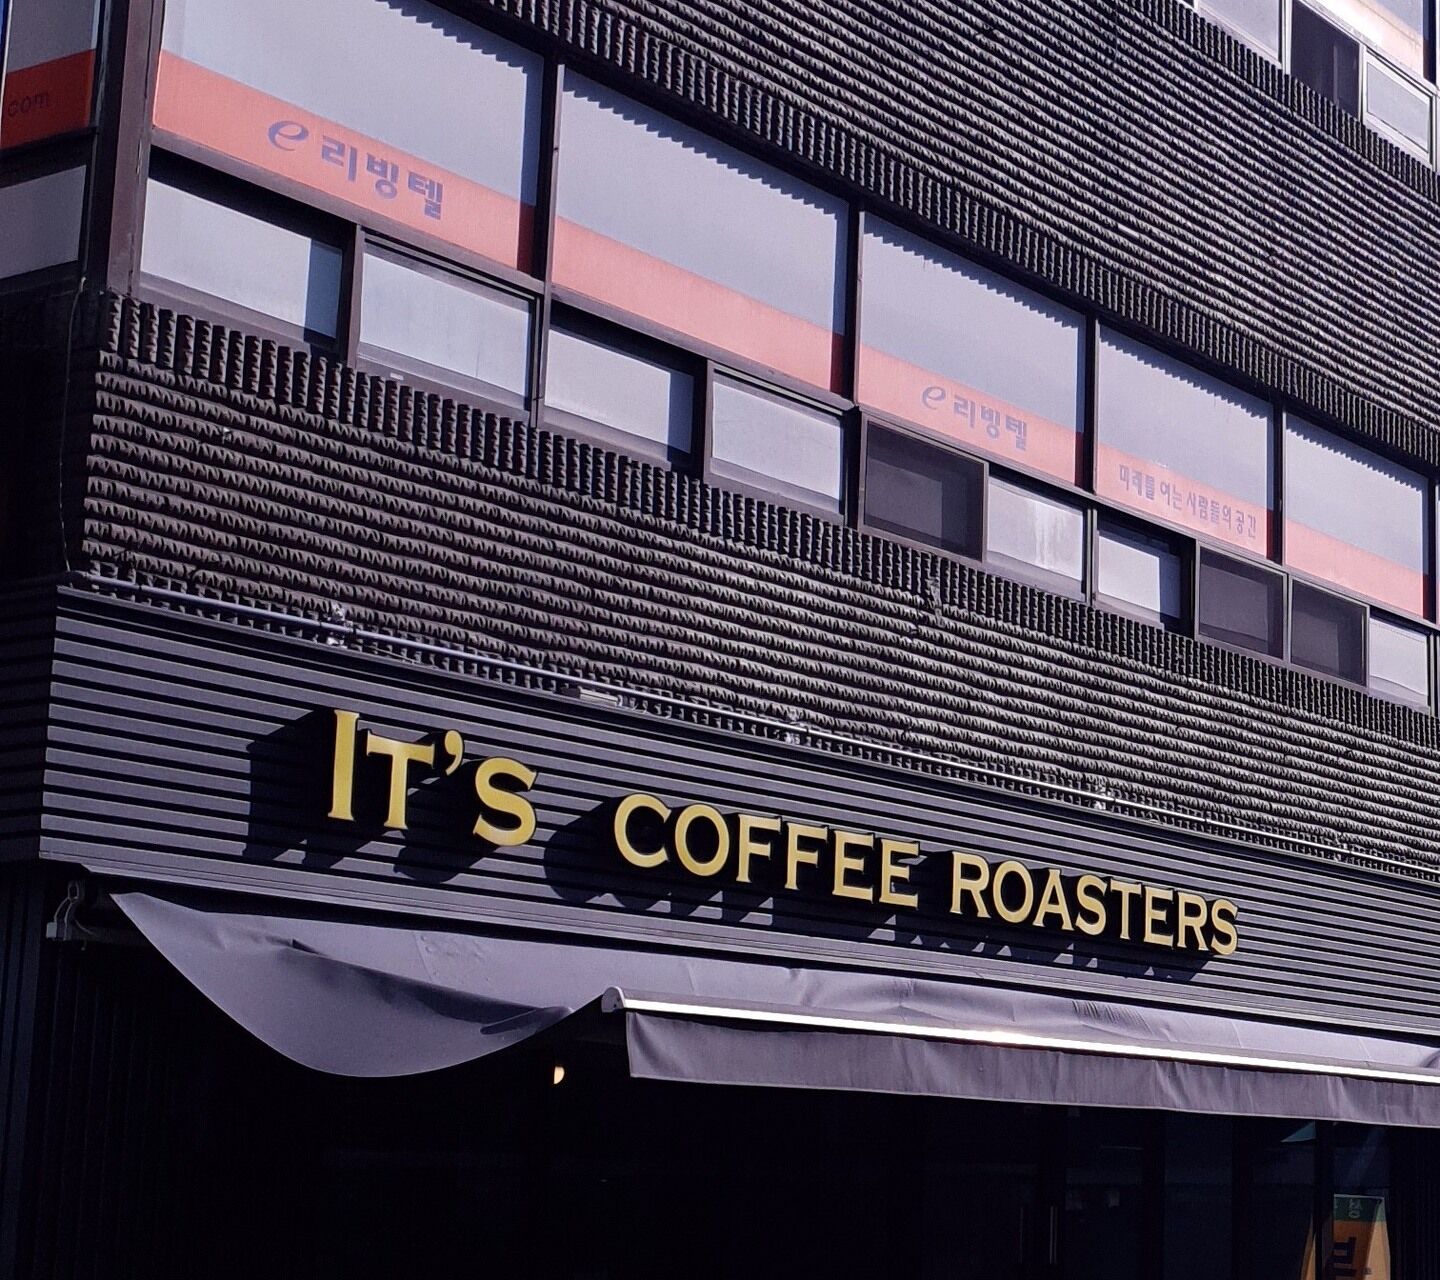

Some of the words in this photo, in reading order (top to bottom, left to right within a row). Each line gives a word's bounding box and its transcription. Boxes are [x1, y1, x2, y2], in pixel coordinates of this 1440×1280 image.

[1119, 464, 1155, 500] 미래를
[1160, 481, 1183, 510] 여는
[1186, 491, 1232, 530] 사람들의
[328, 709, 538, 847] IT'S
[614, 793, 919, 909] COFFEE
[950, 851, 1239, 956] ROASTERS
